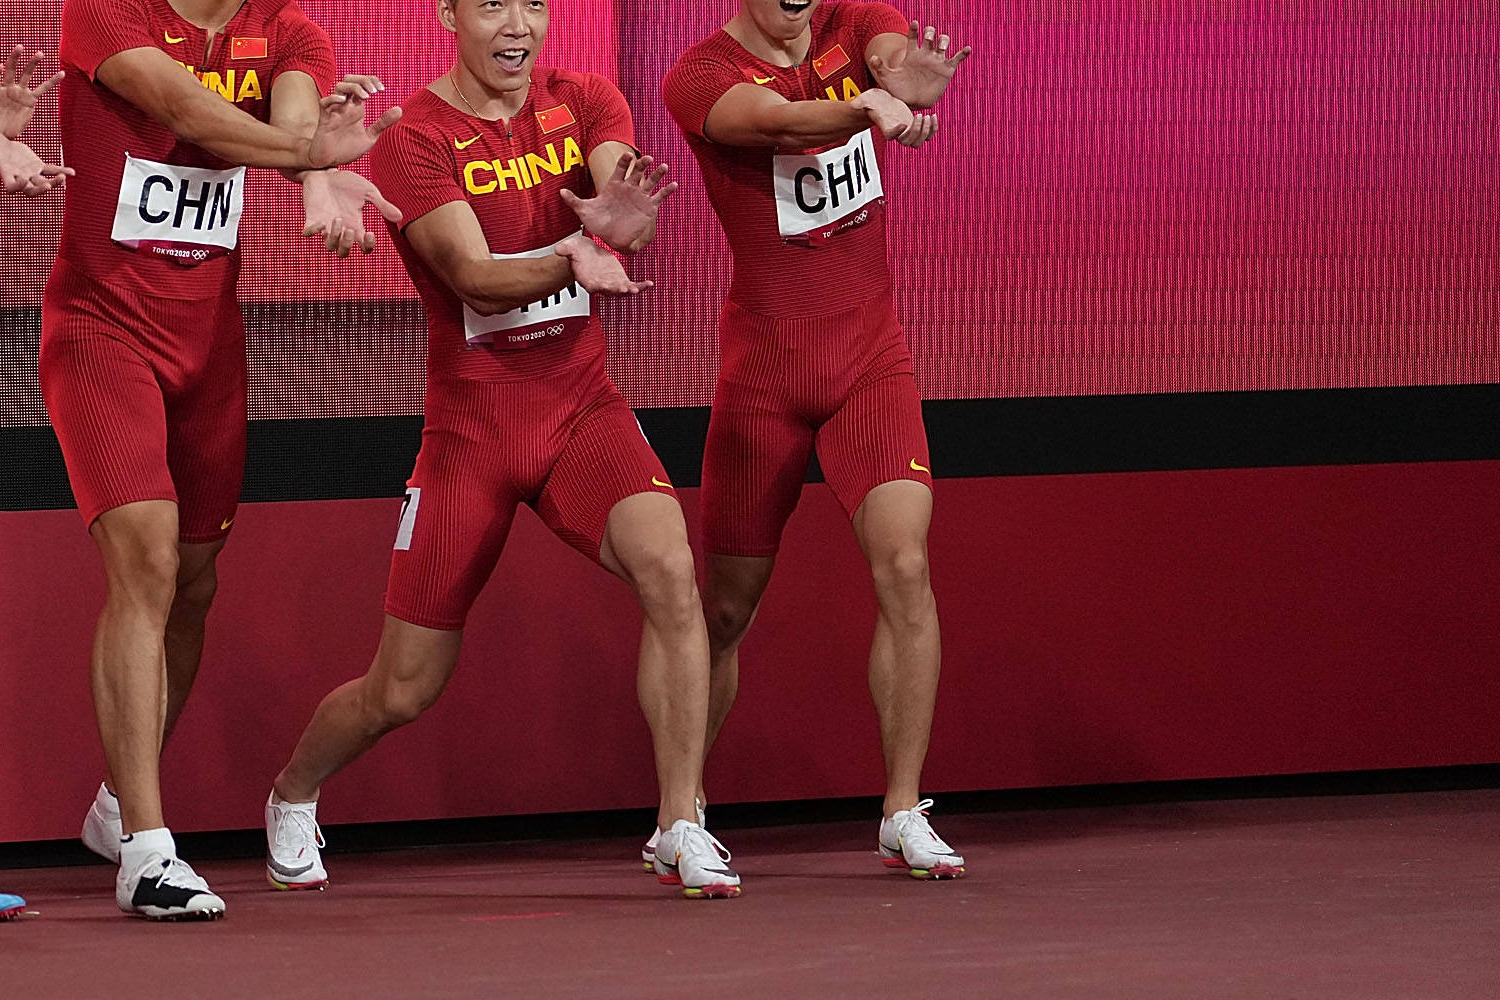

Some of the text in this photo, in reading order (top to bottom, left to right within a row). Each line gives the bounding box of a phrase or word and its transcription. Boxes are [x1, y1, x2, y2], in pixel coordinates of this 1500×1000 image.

[463, 136, 585, 195] CHINA
[794, 138, 870, 214] CHN
[138, 174, 234, 231] CHN
[152, 246, 190, 258] TOKYO 2020
[508, 330, 546, 343] TOKYO 2020
